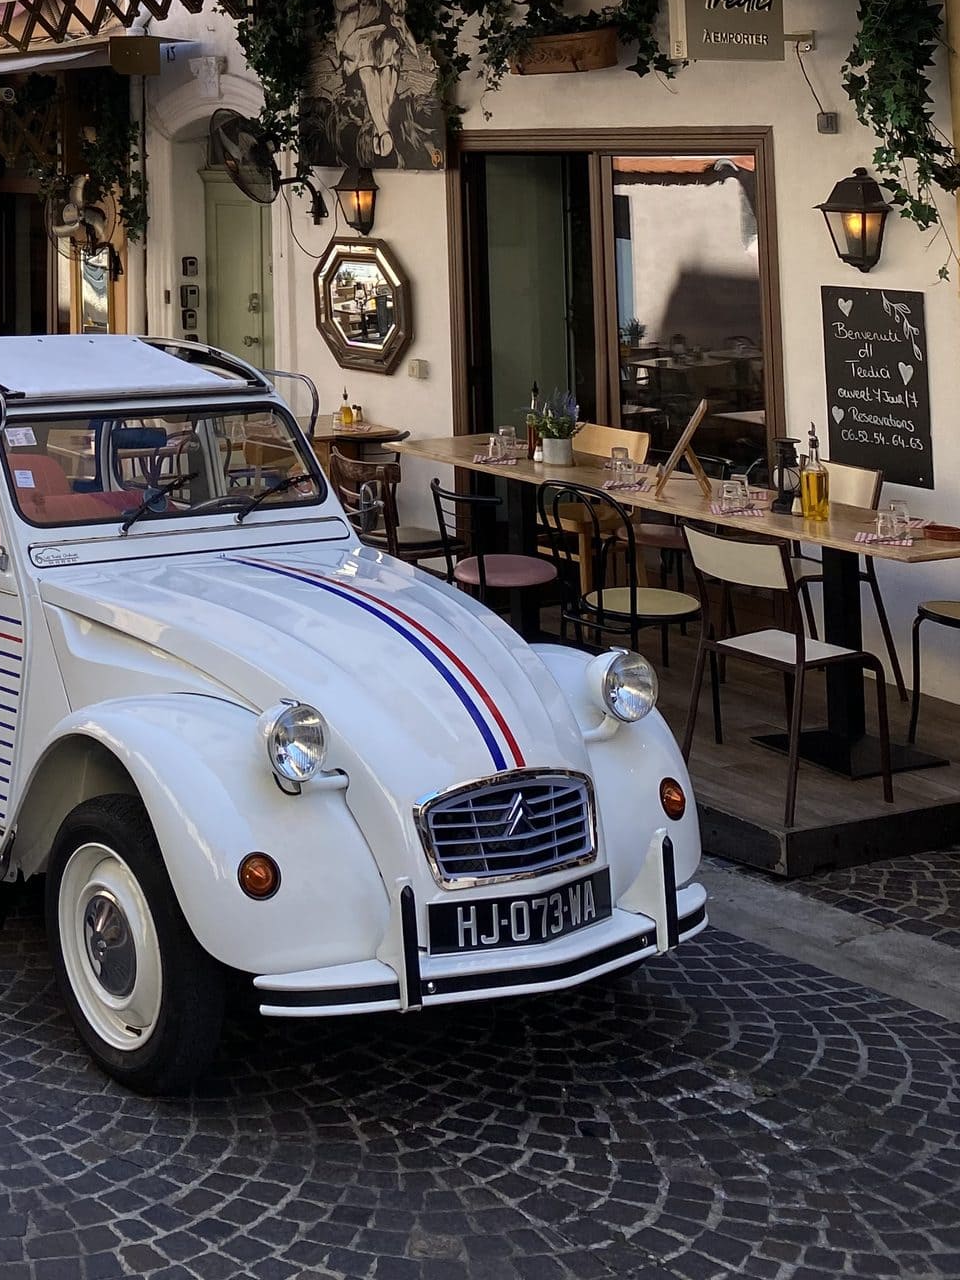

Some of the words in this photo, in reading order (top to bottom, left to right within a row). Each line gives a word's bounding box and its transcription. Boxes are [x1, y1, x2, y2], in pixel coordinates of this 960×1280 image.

[711, 31, 770, 46] EMPORTER
[832, 322, 903, 343] Benvenuti
[456, 880, 597, 948] HJ-073-WA
